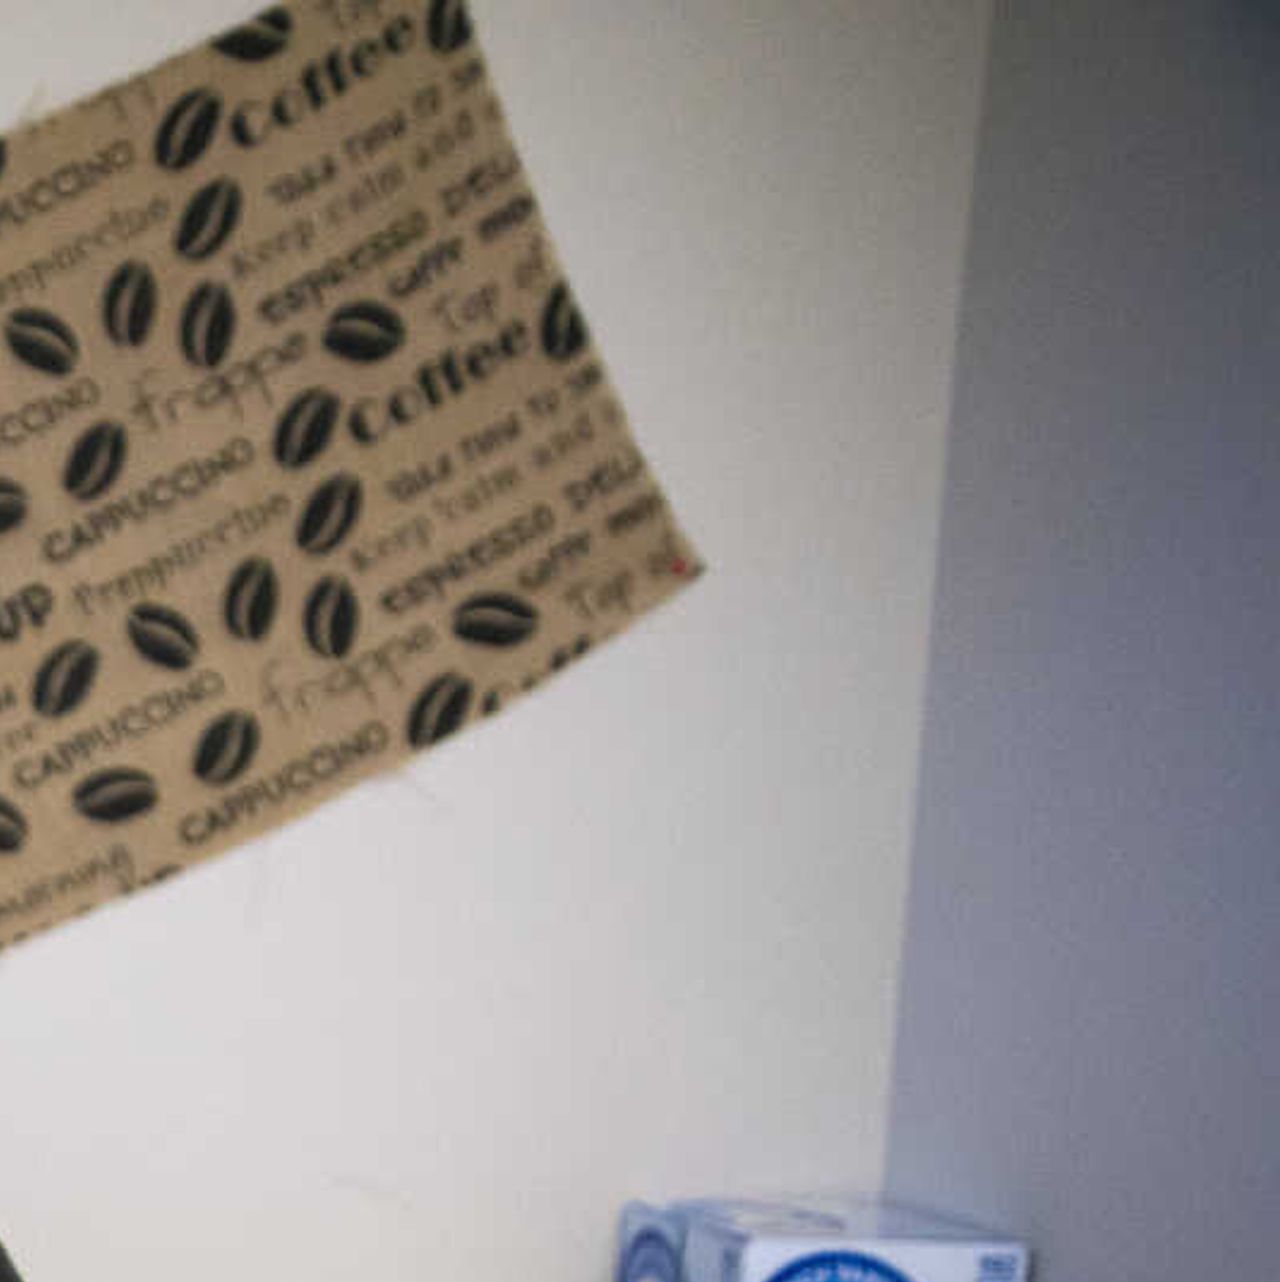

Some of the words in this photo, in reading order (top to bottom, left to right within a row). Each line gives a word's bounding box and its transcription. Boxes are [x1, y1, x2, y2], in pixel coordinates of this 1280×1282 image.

[40, 436, 257, 563] CAPPUCCINO
[12, 666, 227, 792] CAPPUCCINO
[178, 718, 391, 846] CAPPUCCINO
